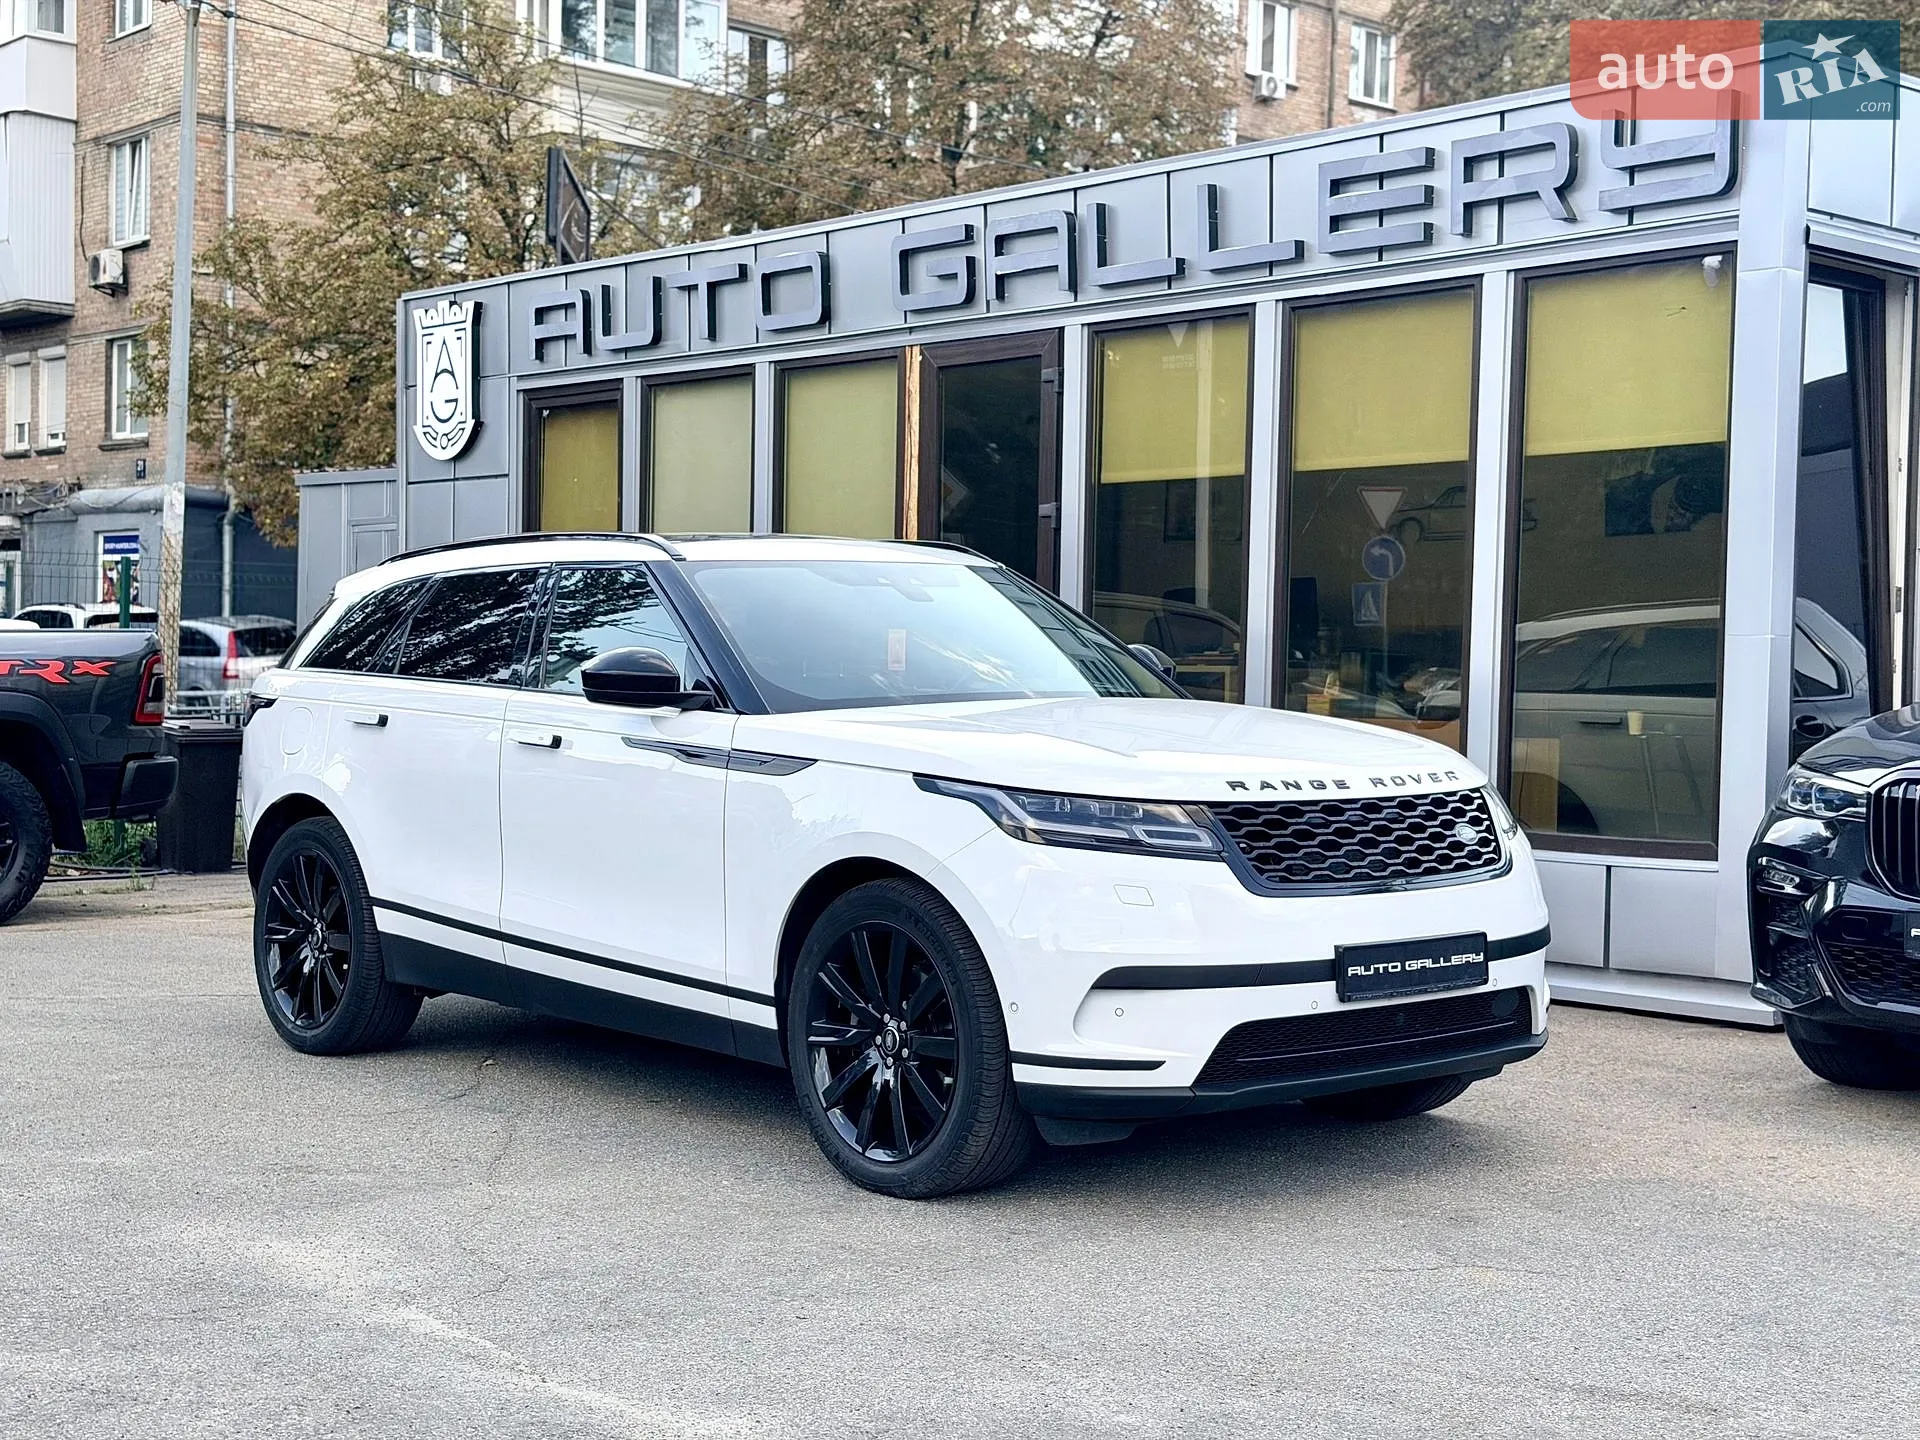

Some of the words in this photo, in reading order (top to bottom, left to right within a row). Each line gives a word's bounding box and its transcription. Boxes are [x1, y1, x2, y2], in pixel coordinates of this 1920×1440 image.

[528, 250, 830, 361] AUTO
[892, 89, 1742, 311] GALLERY
[1225, 779, 1351, 791] RANGE
[1368, 770, 1460, 788] ROVER
[1347, 962, 1401, 977] AUTO
[1405, 952, 1484, 971] GALLERY
